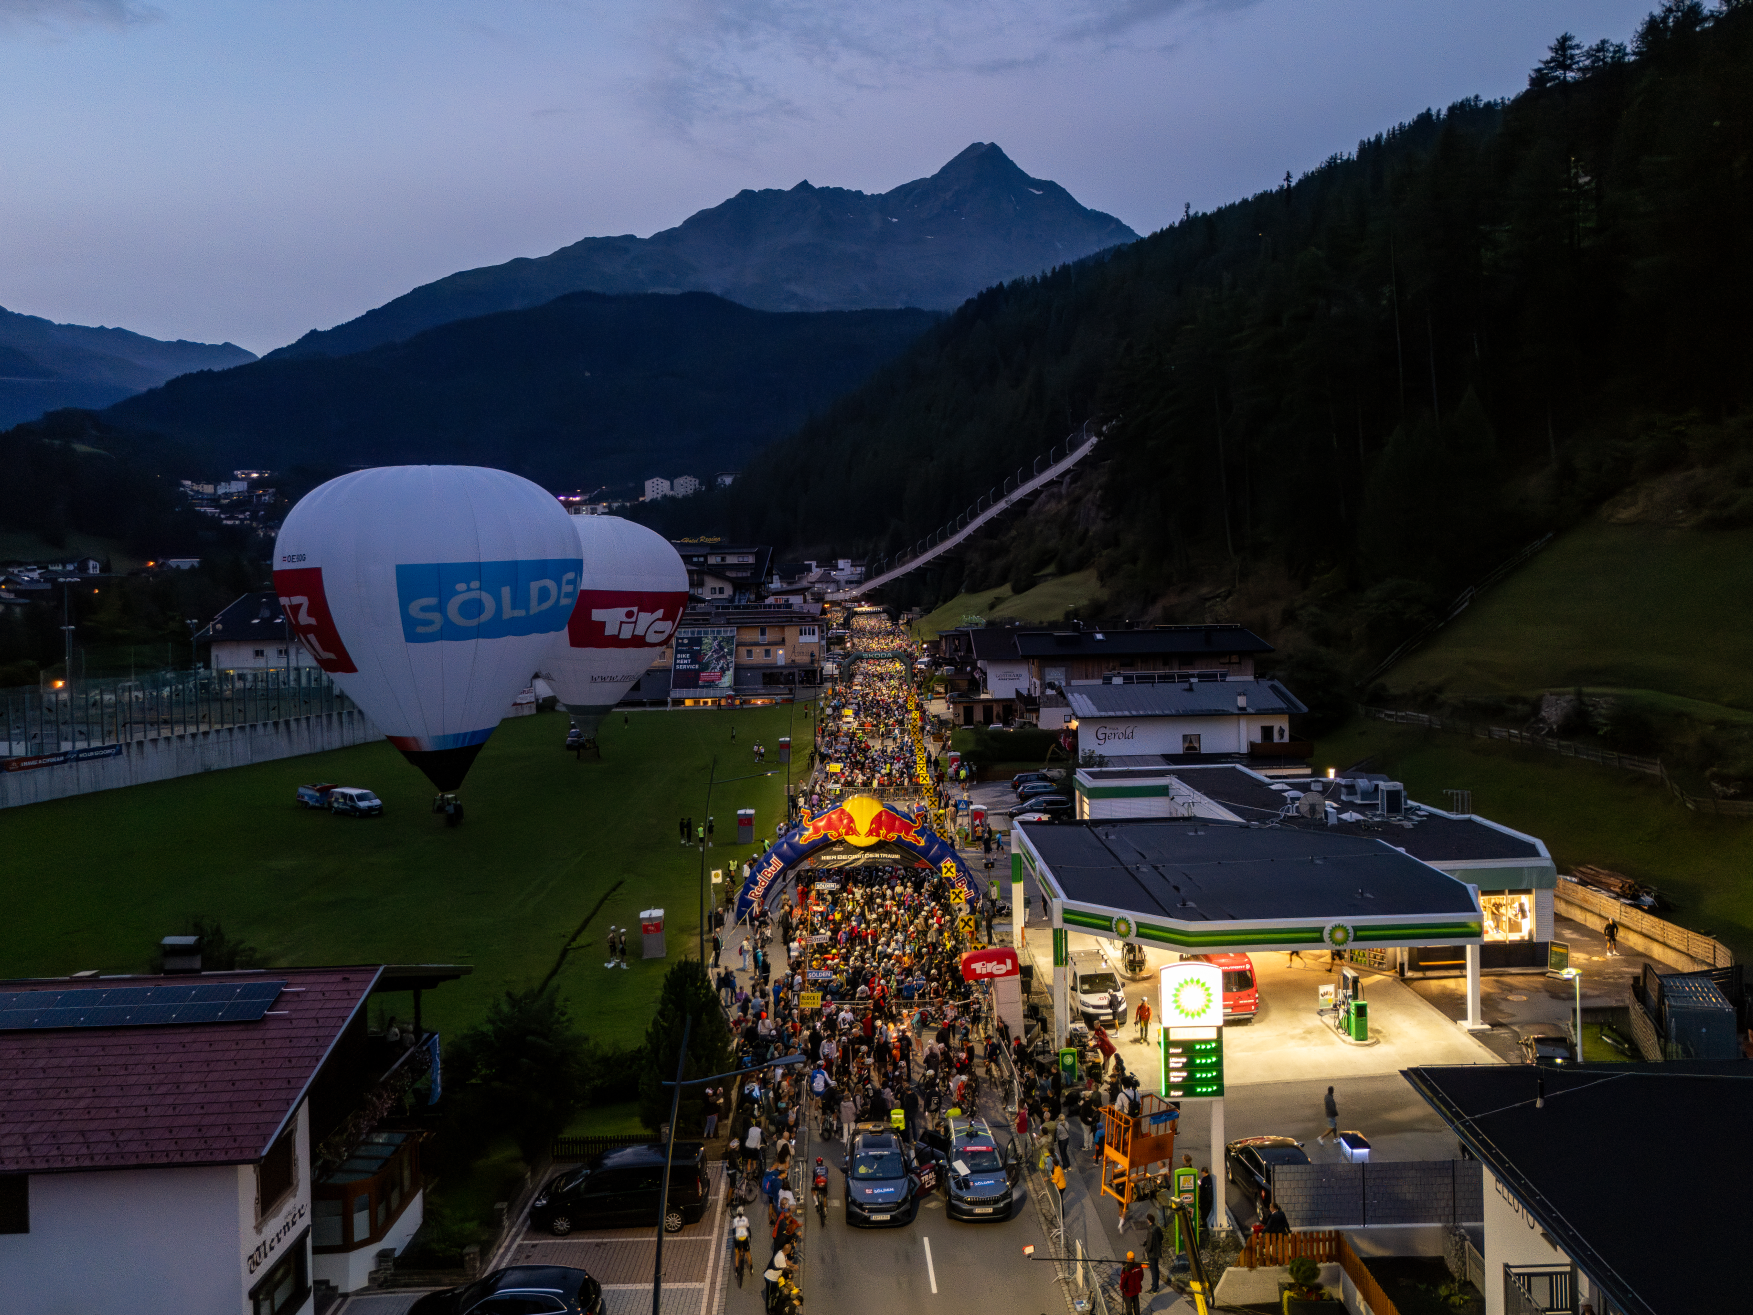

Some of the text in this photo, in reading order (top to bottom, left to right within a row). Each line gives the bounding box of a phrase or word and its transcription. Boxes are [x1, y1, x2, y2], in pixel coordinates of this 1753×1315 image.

[591, 606, 683, 643] Tirol
[1095, 725, 1138, 746] Gerold
[747, 855, 784, 901] Red Bull
[970, 958, 1013, 975] Tirol
